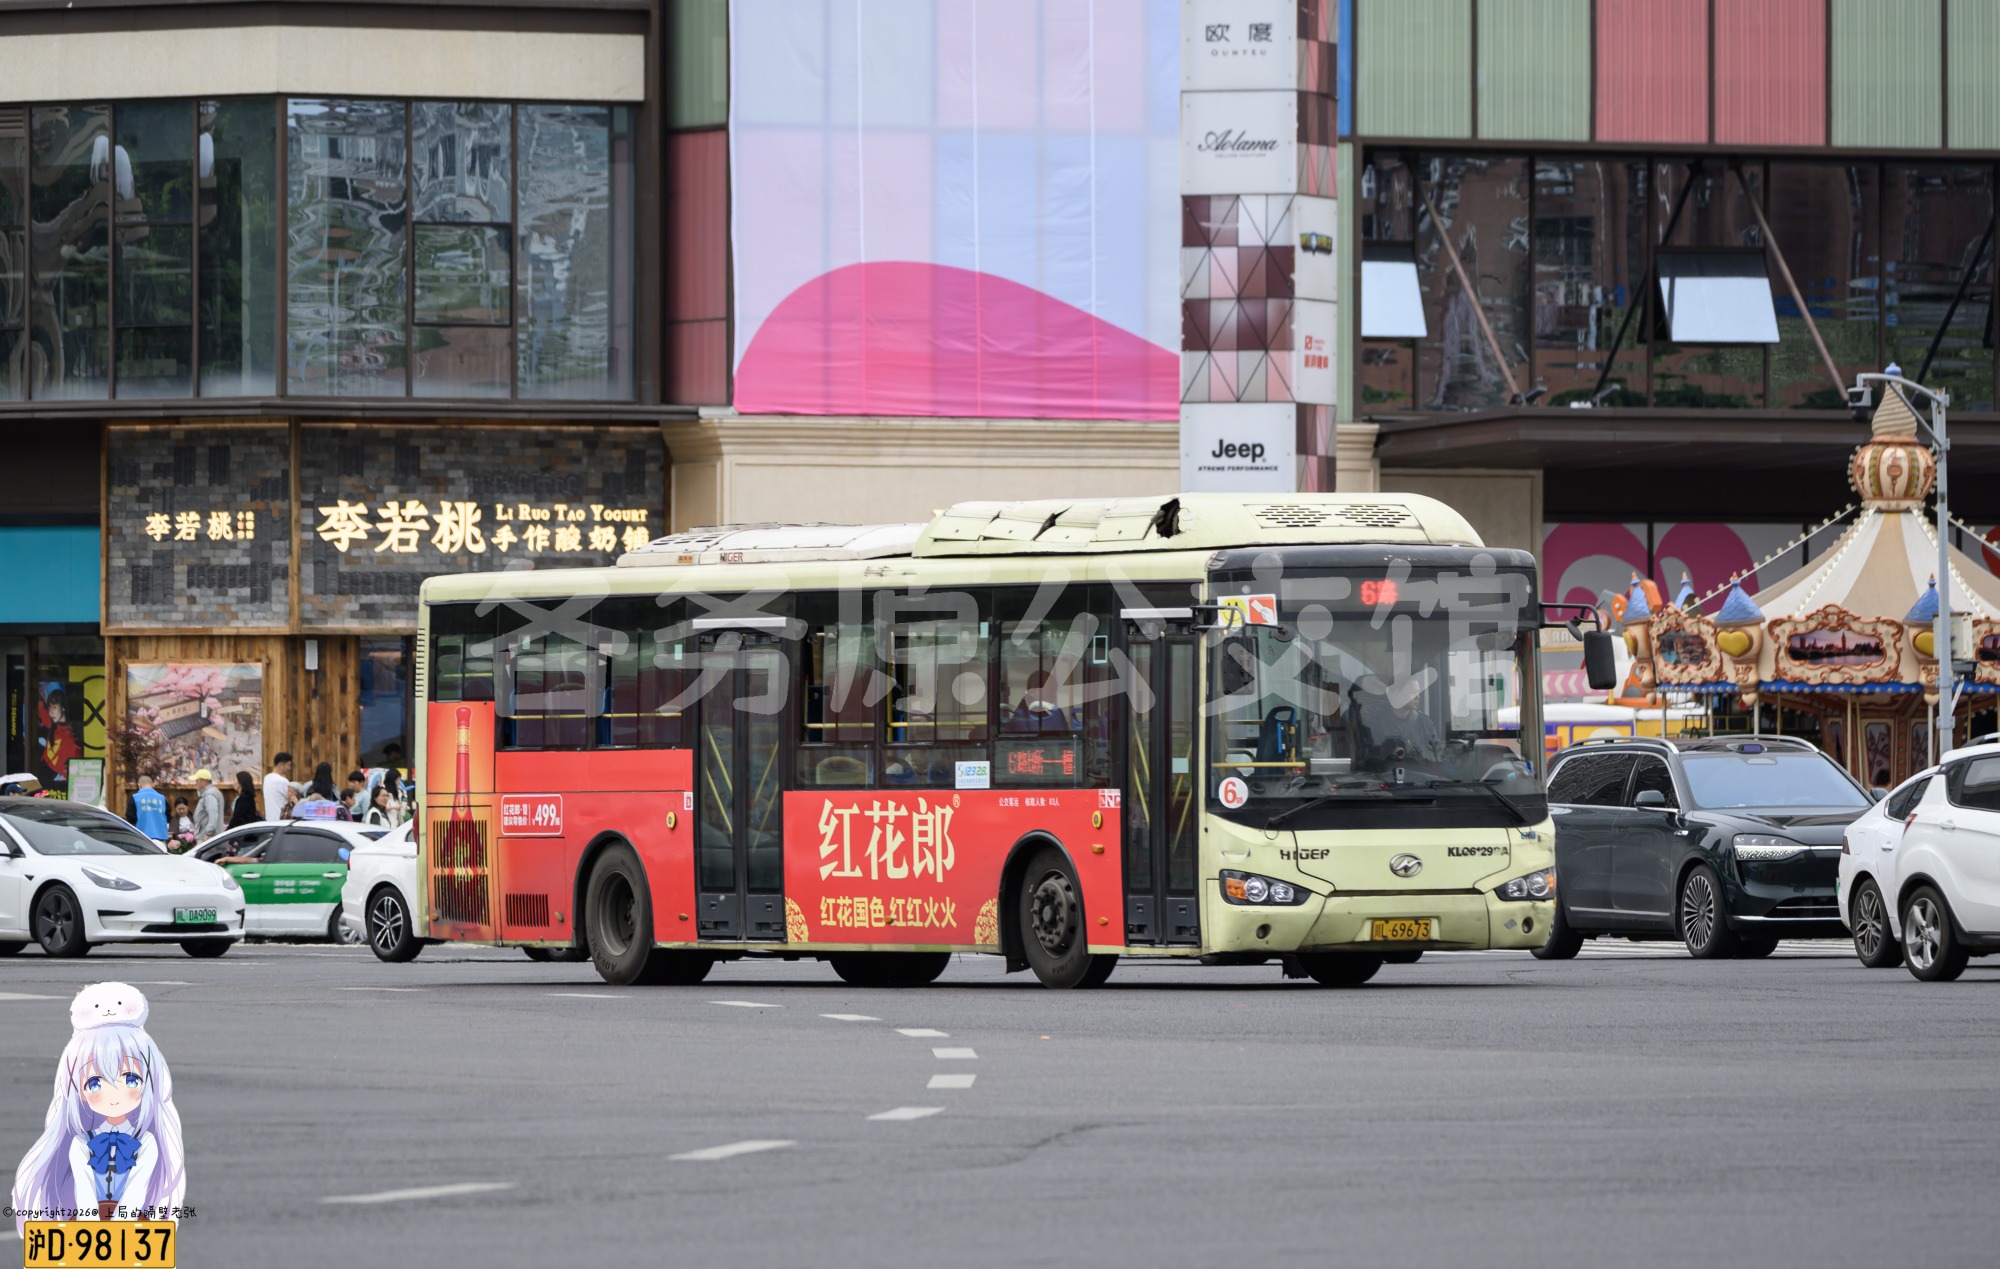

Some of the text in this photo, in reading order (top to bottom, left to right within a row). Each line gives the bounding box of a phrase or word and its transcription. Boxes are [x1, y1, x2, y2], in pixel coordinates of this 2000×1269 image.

[1212, 439, 1265, 463] Jeep
[145, 511, 234, 541] 李若桃
[316, 500, 487, 554] 李若桃
[491, 523, 650, 553] 手作酸奶铺
[818, 797, 955, 883] 红花郎
[820, 896, 957, 929] 红花国色 红红火火
